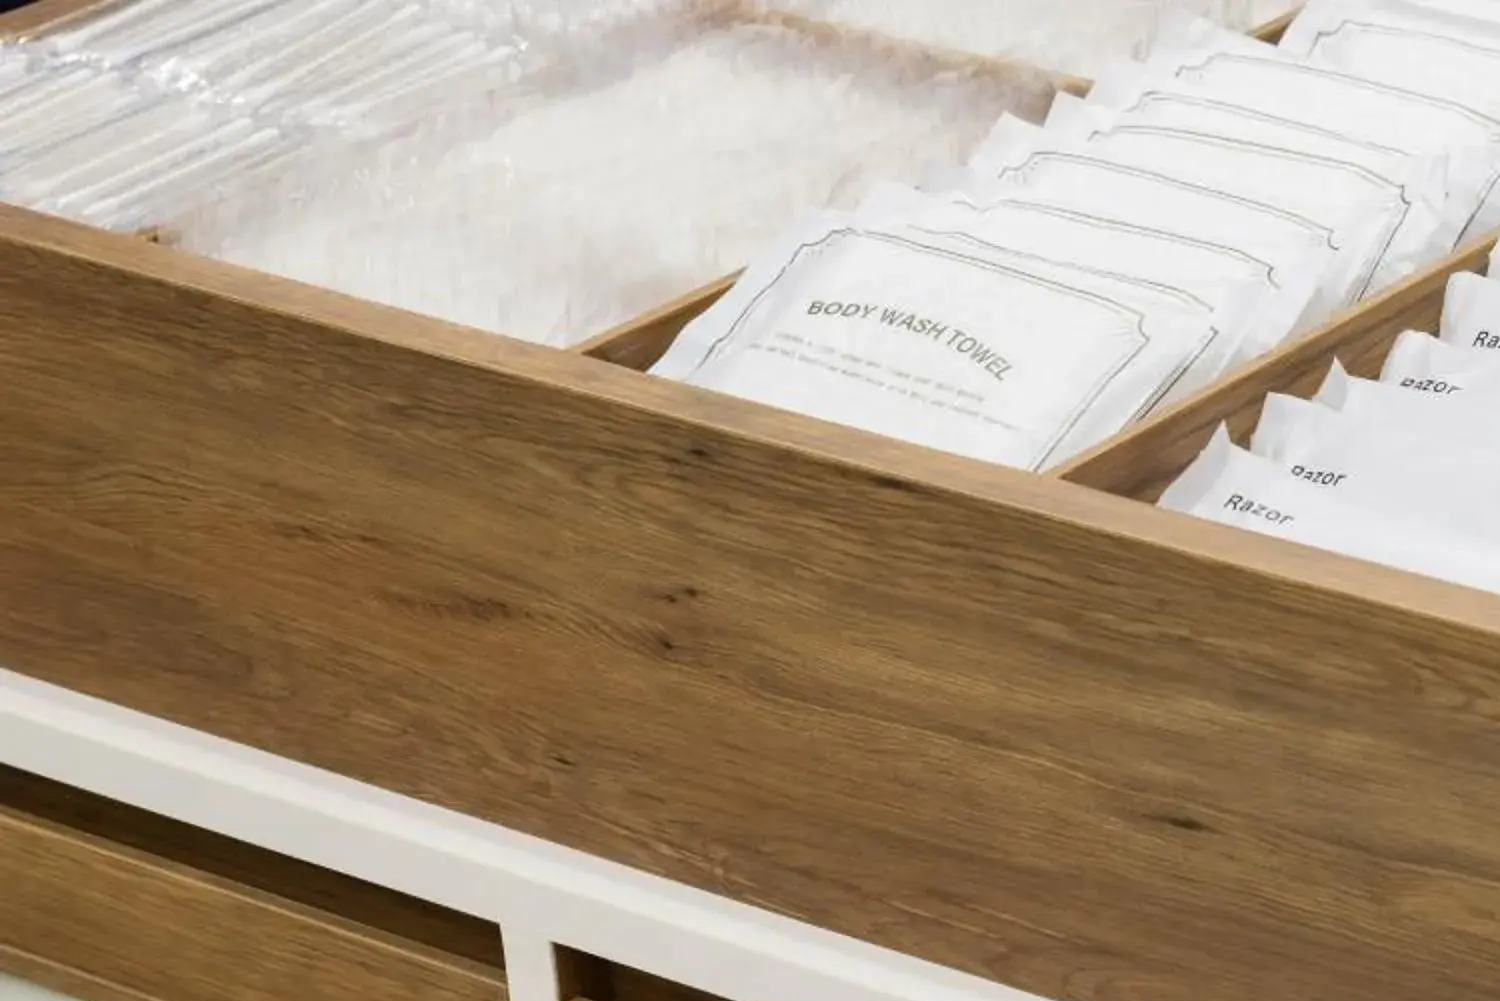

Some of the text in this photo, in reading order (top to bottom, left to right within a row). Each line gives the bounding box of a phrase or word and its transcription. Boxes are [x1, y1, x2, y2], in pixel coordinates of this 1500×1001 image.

[807, 300, 1014, 381] BODY WASH TOWEL
[1223, 493, 1295, 527] Razor
